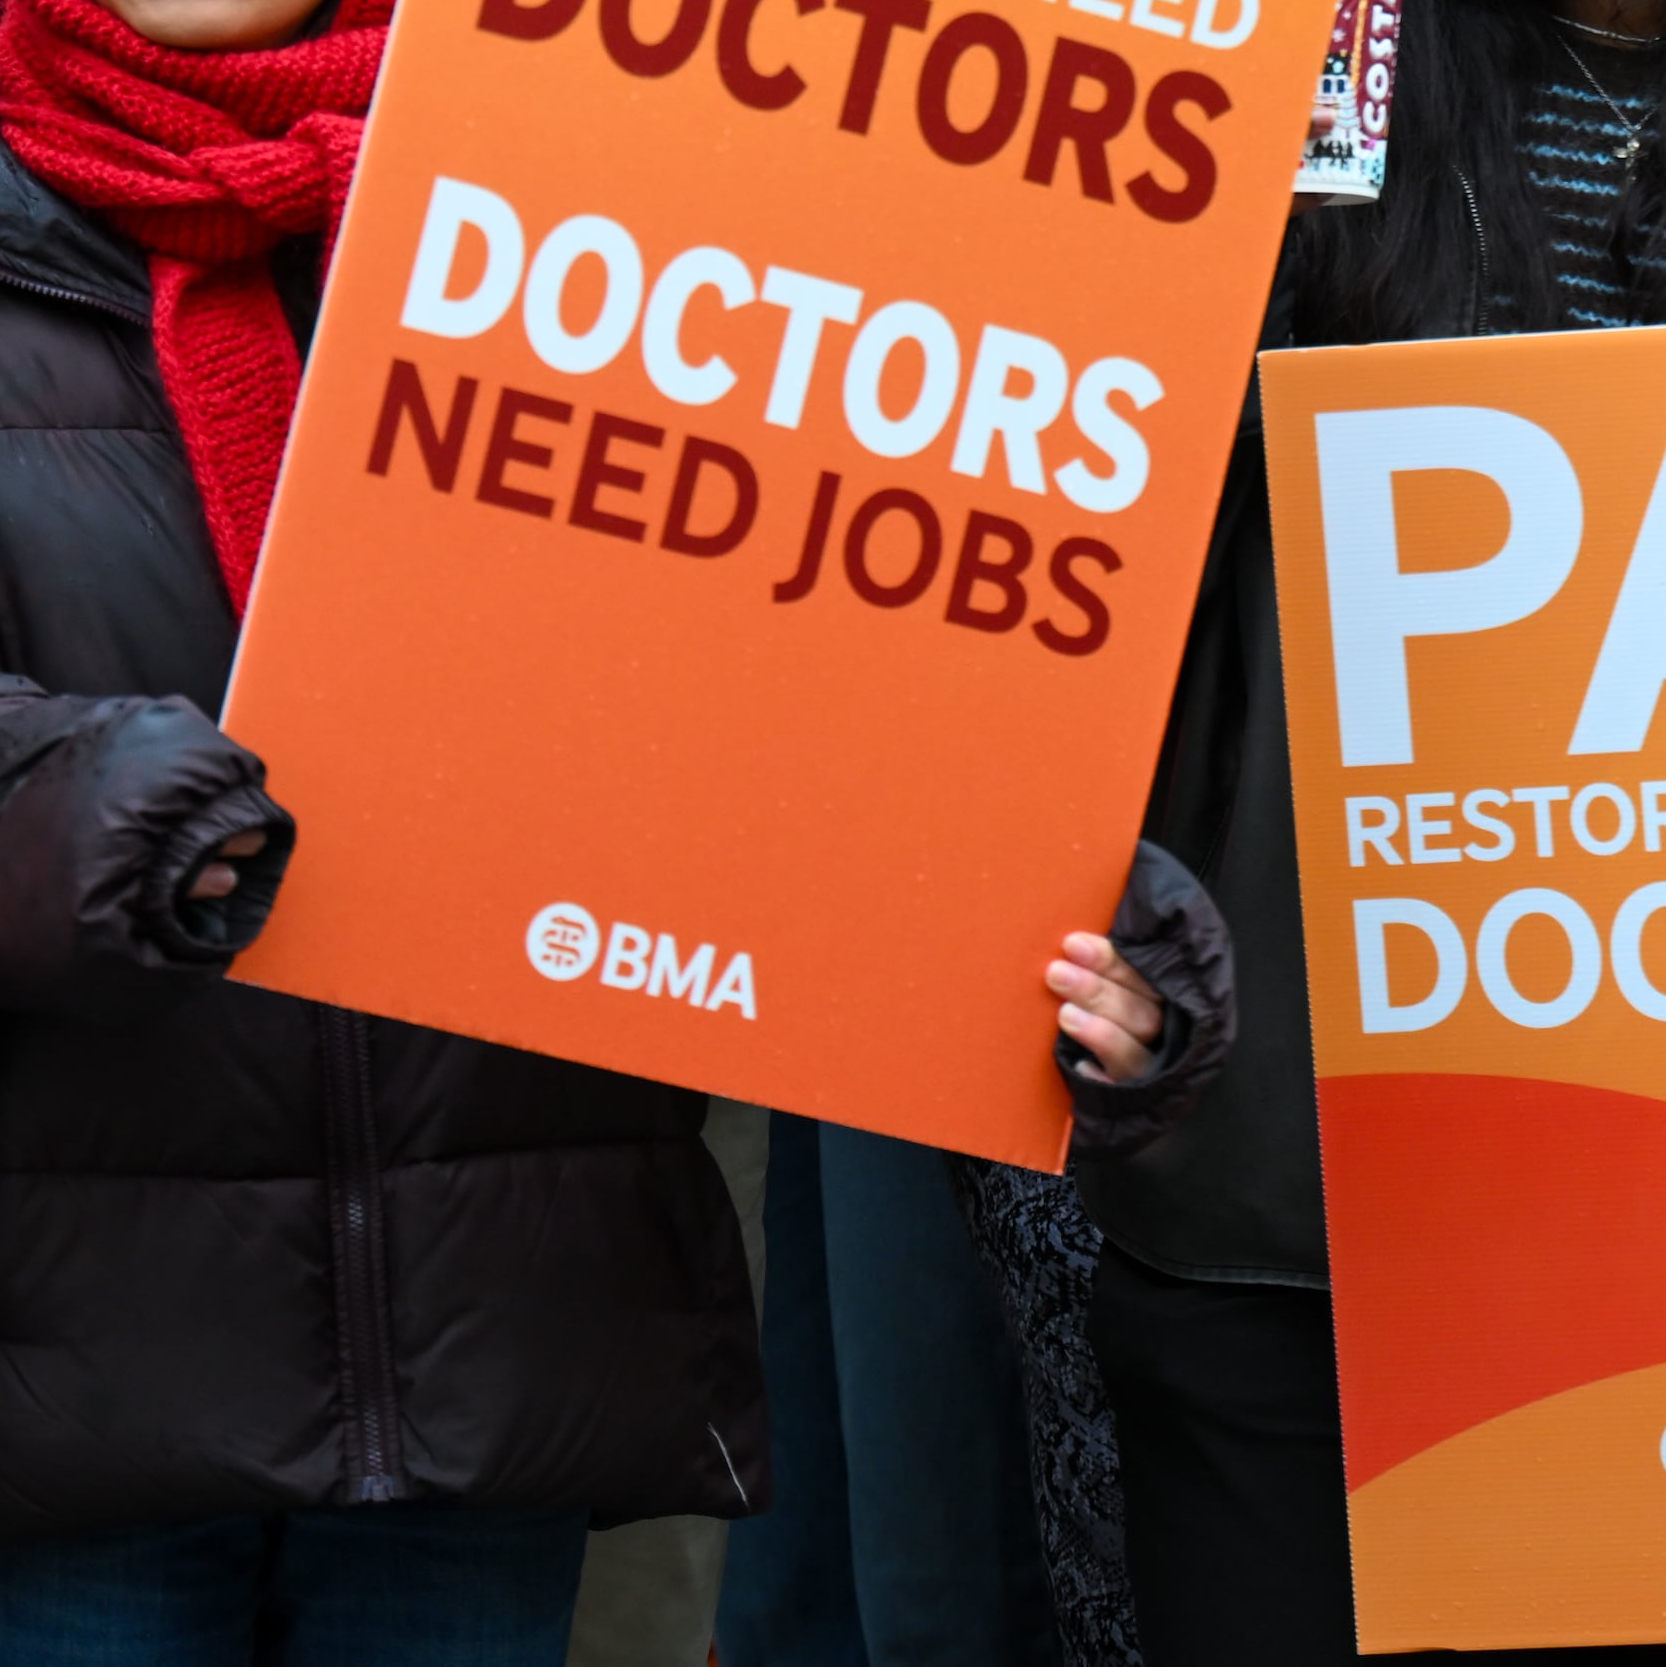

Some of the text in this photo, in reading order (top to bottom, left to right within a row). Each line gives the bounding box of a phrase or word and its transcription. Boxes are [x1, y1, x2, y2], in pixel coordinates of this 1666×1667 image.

[401, 176, 1164, 512] DOCTORS
[365, 358, 1123, 657] NEED JOBS
[600, 922, 757, 1020] BMA
